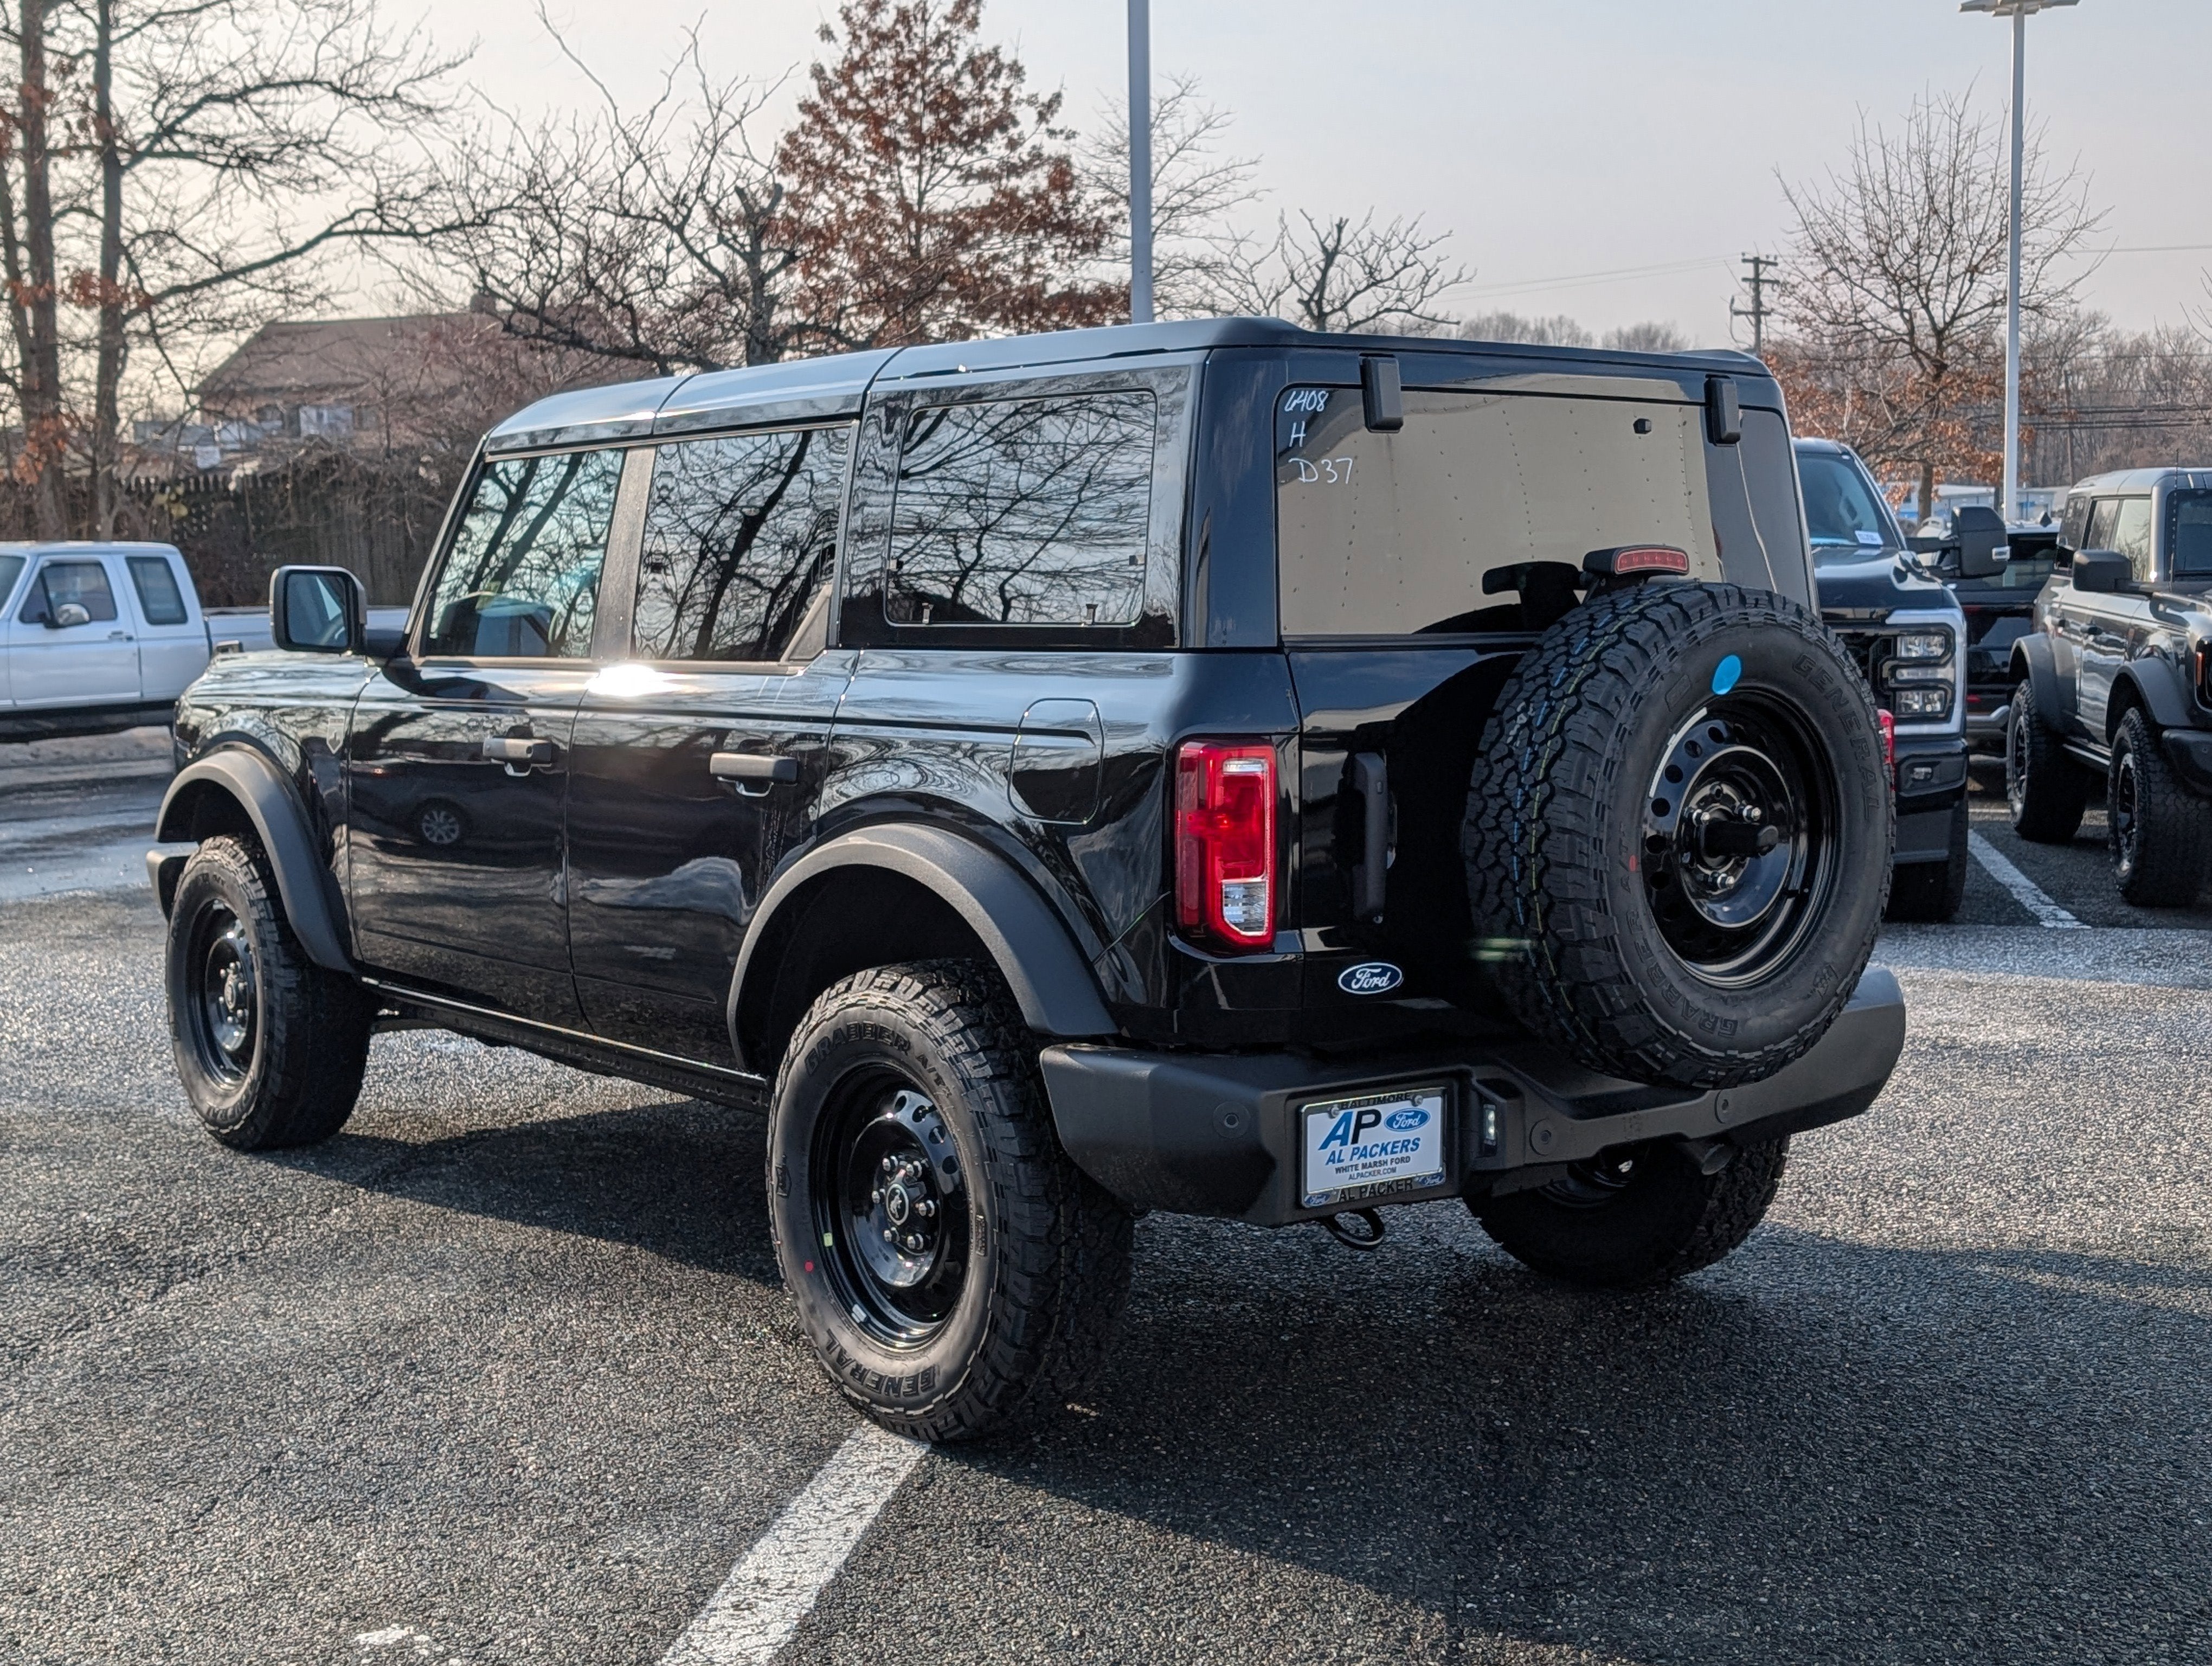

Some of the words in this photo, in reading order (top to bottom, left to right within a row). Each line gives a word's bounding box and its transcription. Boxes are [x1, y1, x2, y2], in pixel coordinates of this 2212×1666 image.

[1289, 420, 1307, 447] H
[1792, 653, 1880, 821] GENERAL
[1351, 968, 1392, 989] Ford
[804, 1020, 911, 1076] GRABBER
[1340, 1092, 1411, 1110] BALTIMORE
[1318, 1108, 1381, 1151] AP
[1392, 1111, 1421, 1129] Ford
[1325, 1149, 1345, 1165] AL
[1350, 1137, 1421, 1161] PACKERS
[1335, 1163, 1359, 1174] WHITE
[1361, 1158, 1388, 1170] MARSH
[1390, 1156, 1411, 1165] FORD
[1348, 1167, 1397, 1181] ALPACKER.COM
[1338, 1188, 1355, 1203] AL
[1359, 1179, 1413, 1198] PACKER
[826, 1328, 937, 1398] GENERAL
